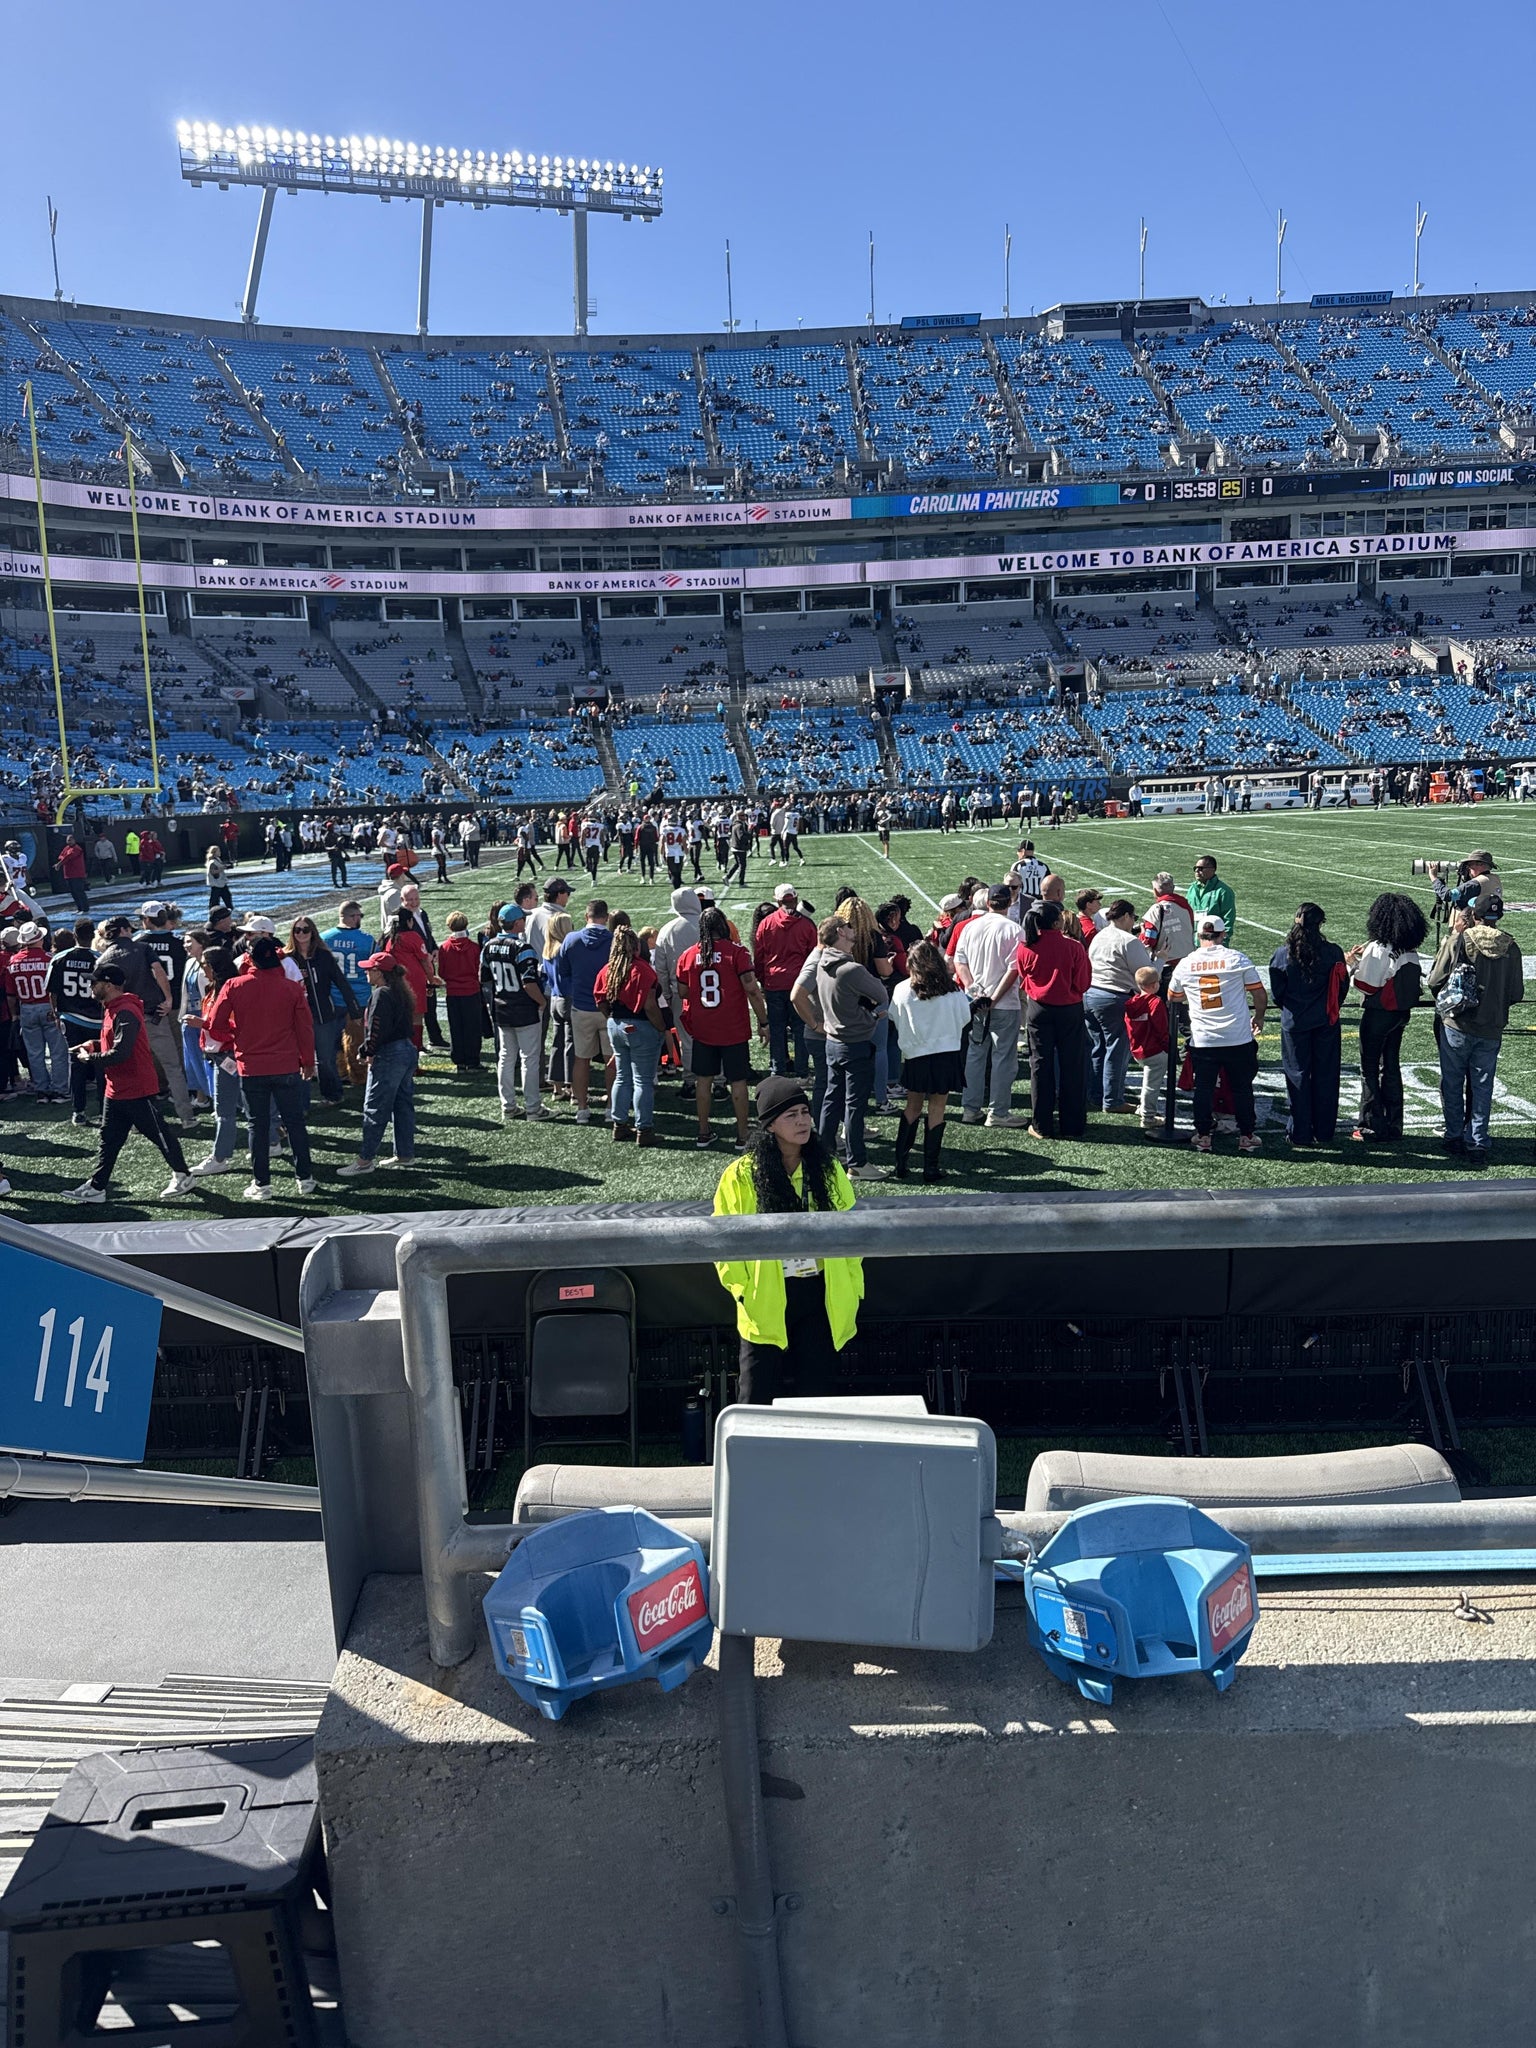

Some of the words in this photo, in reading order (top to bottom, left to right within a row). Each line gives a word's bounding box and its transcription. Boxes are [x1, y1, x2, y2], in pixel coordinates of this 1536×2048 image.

[1316, 296, 1335, 305] MIKE
[1338, 294, 1387, 304] McCORMACK
[916, 318, 931, 326] PSL
[933, 317, 966, 325] OWNERS
[1393, 472, 1437, 487] FOLLOW
[1439, 472, 1454, 484] US
[1457, 470, 1473, 484] ON
[1475, 468, 1514, 482] SOCIAL
[1144, 484, 1155, 500] 0
[1174, 482, 1217, 499] 35:58
[1222, 480, 1241, 497] 25
[1262, 478, 1273, 495] 0
[1308, 482, 1313, 492] 1
[87, 490, 181, 512] WELCOME
[188, 500, 211, 514] TO
[219, 502, 271, 518] BANK
[276, 506, 299, 520] OF
[304, 508, 387, 523] AMERICA
[394, 511, 476, 526] STADIUM
[909, 492, 980, 514] CAROLINA
[983, 489, 1060, 510] PANTHERS
[629, 514, 663, 524] BANK
[666, 514, 683, 524] OF
[685, 512, 742, 523] AMERICA
[774, 508, 832, 519] STADIUM
[998, 552, 1100, 572] WELCOME
[1110, 551, 1135, 566] TO
[1143, 547, 1202, 564] BANK
[1208, 546, 1236, 561] OF
[1241, 540, 1340, 559] AMERICA
[1350, 535, 1450, 554] STADIUM
[200, 575, 236, 586] BANK
[239, 576, 256, 586] OF
[259, 577, 317, 588] AMERICA
[350, 580, 408, 590] STADIUM
[548, 580, 582, 590] BANK
[584, 580, 600, 590] OF
[602, 579, 656, 589] AMERICA
[686, 576, 741, 587] STADIUM
[666, 832, 683, 846] 84
[1027, 870, 1039, 878] 74
[333, 939, 355, 949] BEAST
[66, 960, 91, 970] KUECHLY
[695, 952, 722, 965] DIS
[1190, 960, 1226, 972] EGBUKA
[63, 971, 92, 998] 59
[490, 960, 520, 992] 90
[15, 975, 46, 999] 00
[700, 970, 720, 1008] 8
[1198, 974, 1222, 1010] 2
[564, 1288, 584, 1297] BEST
[34, 1307, 114, 1413] 114
[638, 1575, 698, 1636] Coca-Cola
[1211, 1580, 1248, 1637] Coca-Cola
